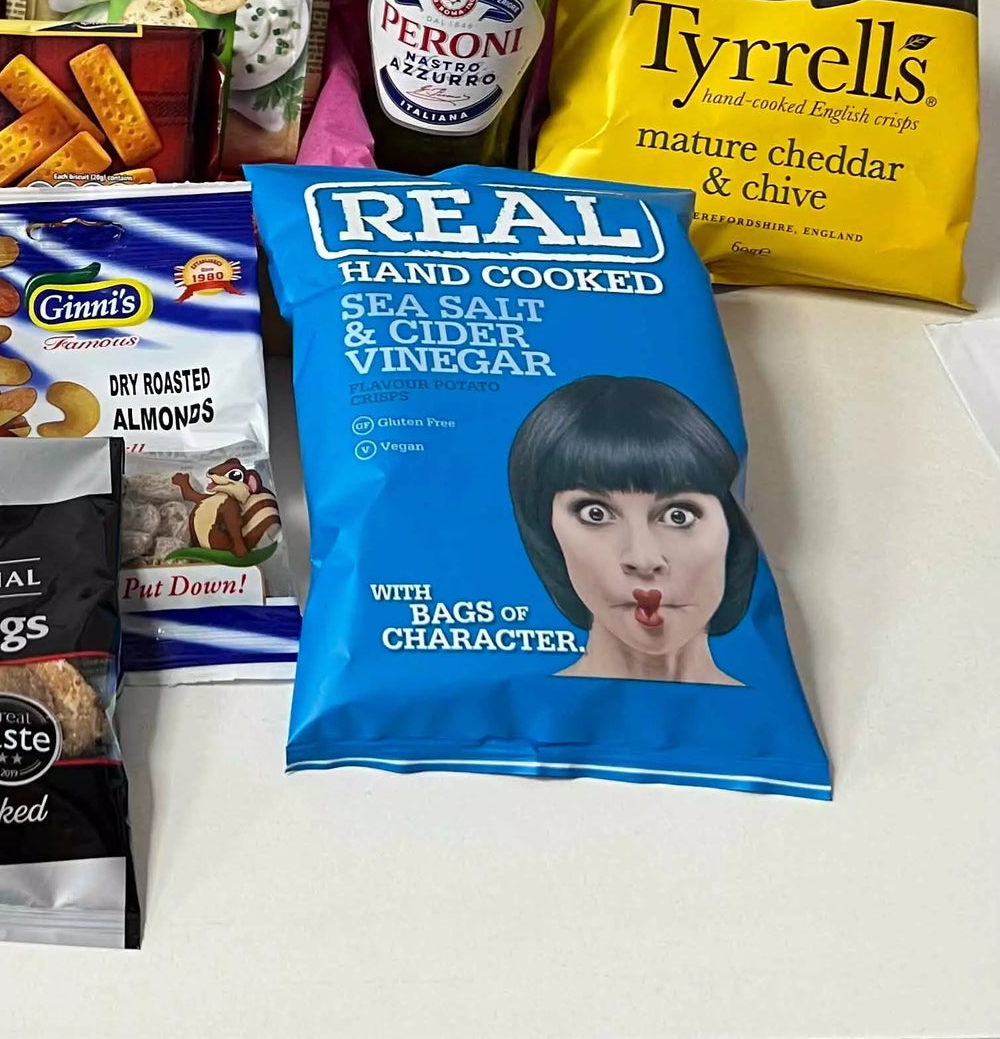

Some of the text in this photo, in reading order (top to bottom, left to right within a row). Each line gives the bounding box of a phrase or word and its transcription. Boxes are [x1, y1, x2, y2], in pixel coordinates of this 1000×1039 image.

[381, 0, 524, 59] PERONI
[390, 57, 496, 87] AZZURRO
[405, 51, 480, 73] NASTRO
[400, 99, 469, 122] ITALIANA
[702, 88, 920, 133] hand-cooked English crisps
[635, 127, 905, 182] mature cheddar
[702, 166, 828, 211] & chive
[331, 188, 643, 250] REAL
[803, 227, 863, 242] ENGLAND
[192, 272, 224, 282] 1980
[338, 261, 665, 296] HAND COOKED
[39, 288, 136, 320] Ginni's
[341, 292, 545, 323] SEA SALT
[43, 335, 138, 351] Famous
[344, 320, 531, 349] & CIDER
[345, 346, 557, 378] VINEGAR
[110, 367, 211, 397] DRY ROASTED
[349, 379, 500, 394] FLAVOUR POTATO
[351, 391, 409, 406] CRISPS
[113, 397, 214, 431] ALMONDS
[377, 418, 456, 428] Gluten Free
[380, 442, 424, 453] Vegan
[123, 573, 248, 600] Put Down!
[370, 584, 432, 601] WITH
[409, 601, 529, 625] BAGS OF
[382, 627, 586, 653] CHARACTER.
